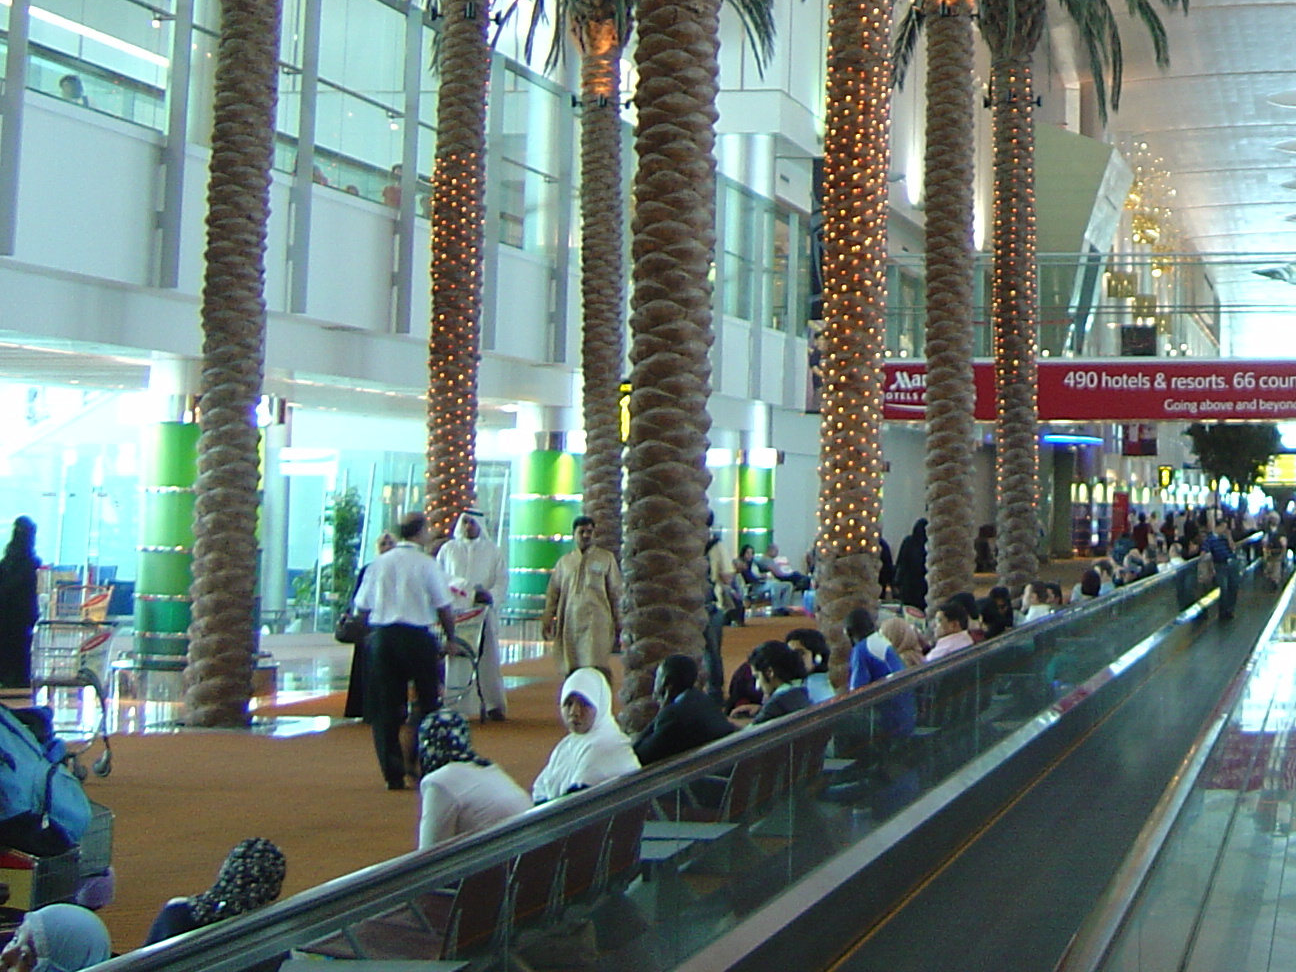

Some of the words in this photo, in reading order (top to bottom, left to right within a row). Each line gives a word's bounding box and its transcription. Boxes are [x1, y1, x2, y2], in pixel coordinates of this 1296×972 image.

[1063, 371, 1099, 388] 490
[1101, 371, 1152, 389] hotels
[1153, 372, 1168, 389] &
[1171, 373, 1230, 389] resorts.
[1232, 371, 1256, 389] 66
[884, 391, 918, 401] OTELS
[1163, 398, 1198, 414] Going
[1199, 398, 1234, 411] above
[1235, 398, 1258, 411] and
